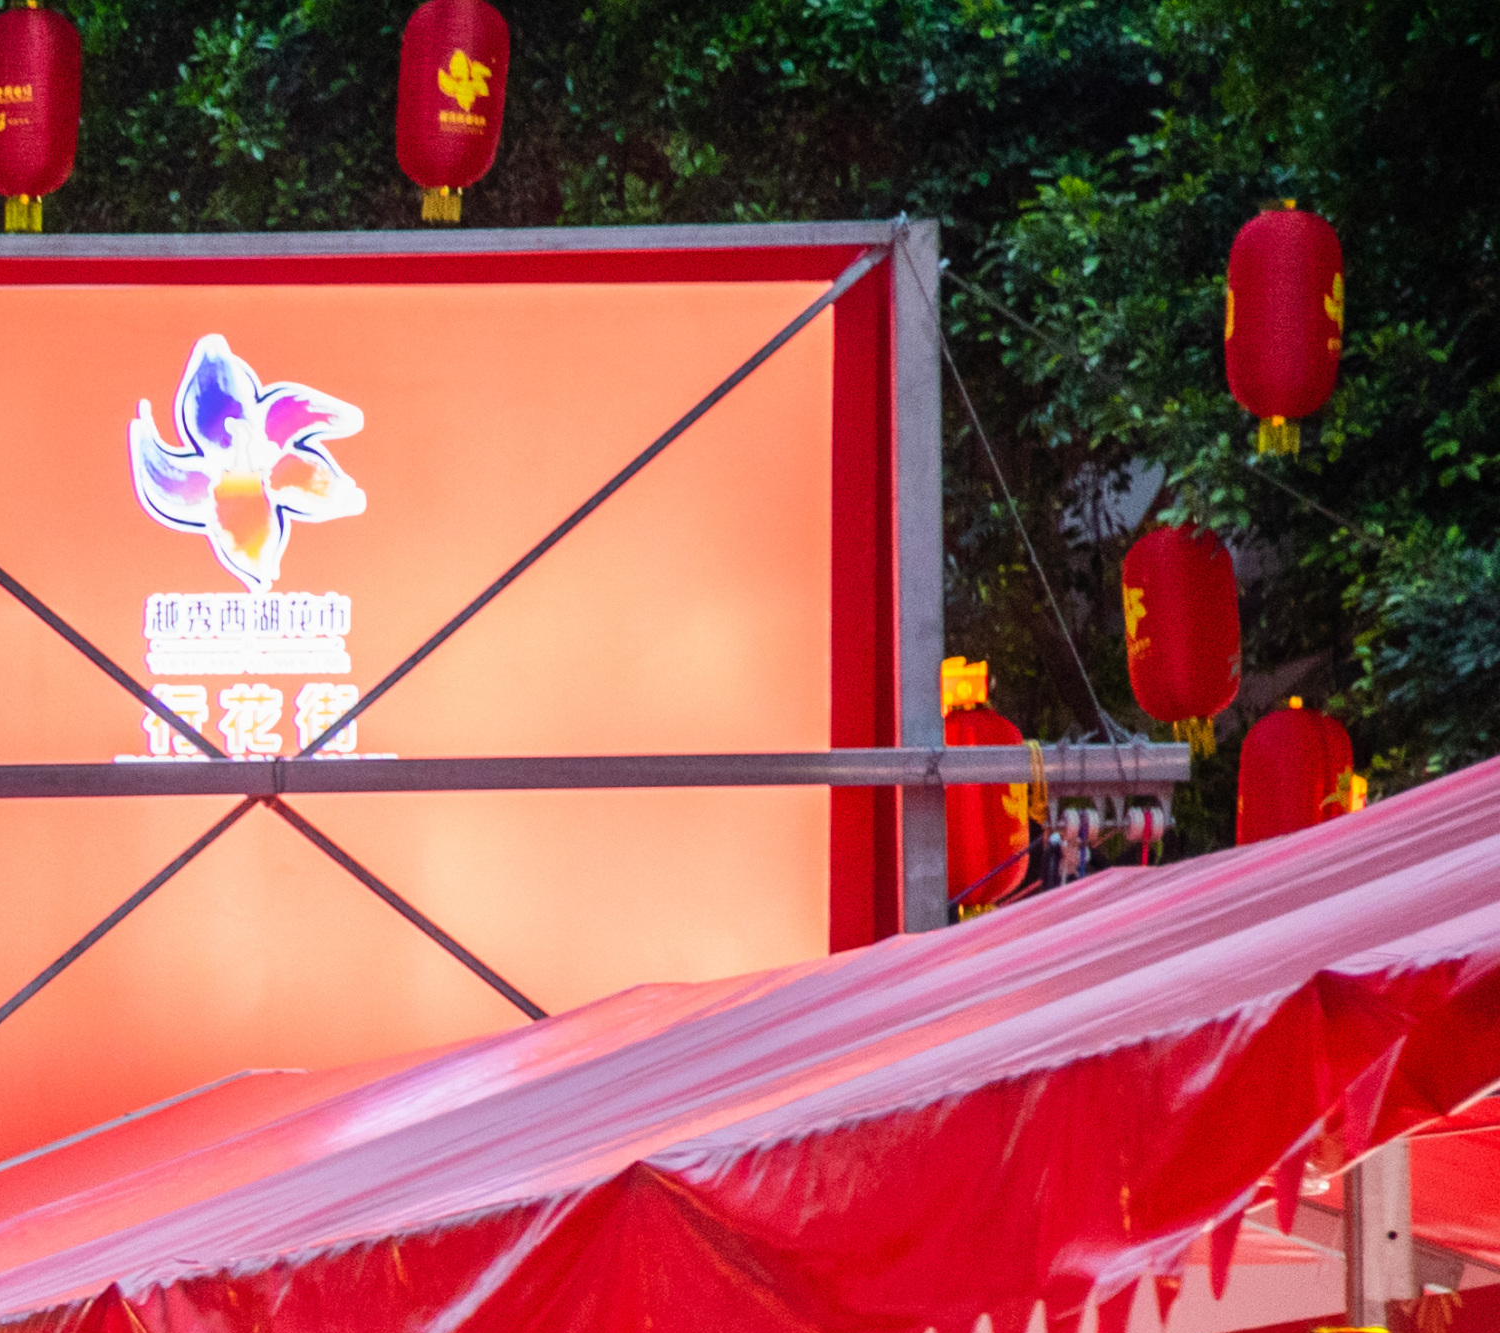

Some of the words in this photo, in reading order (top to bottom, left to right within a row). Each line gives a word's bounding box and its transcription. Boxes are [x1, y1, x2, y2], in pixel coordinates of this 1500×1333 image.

[145, 594, 349, 637] 越秀西湖花市
